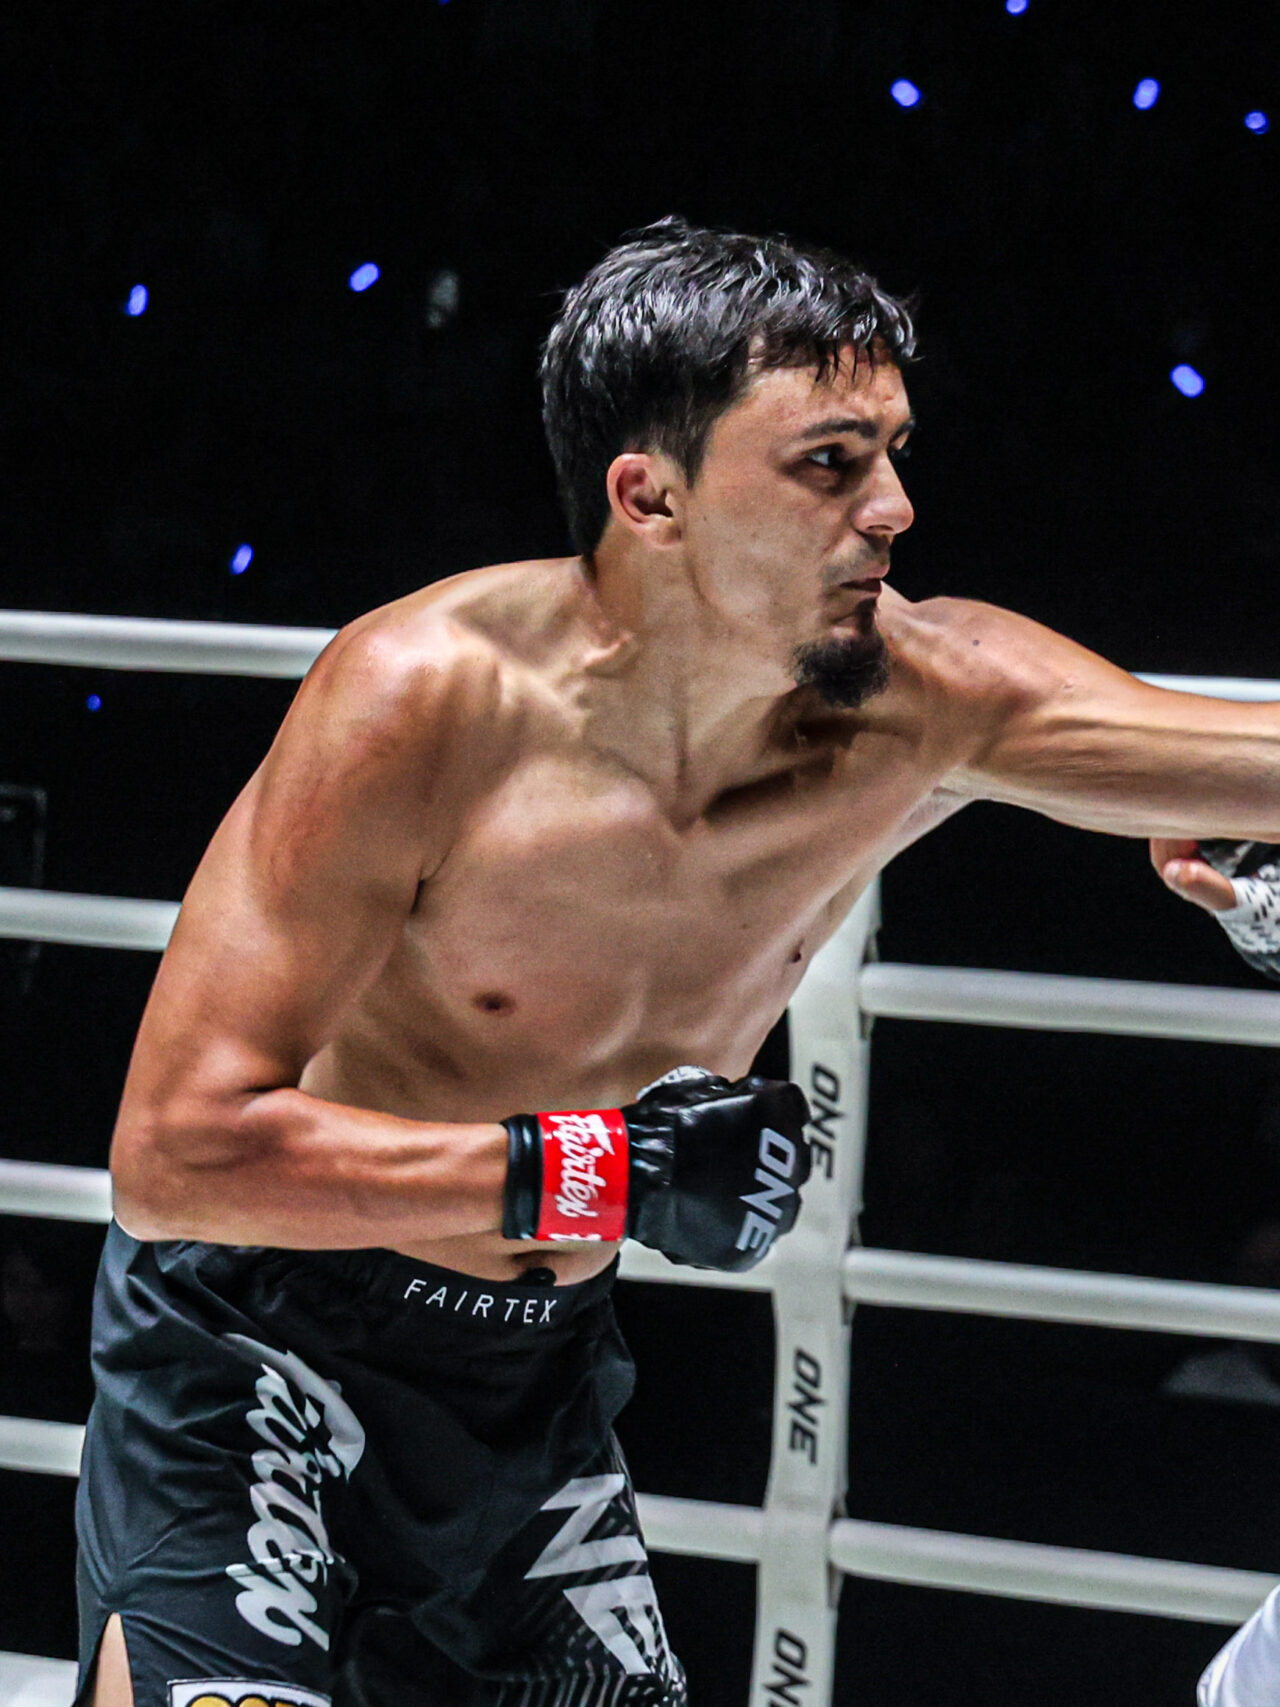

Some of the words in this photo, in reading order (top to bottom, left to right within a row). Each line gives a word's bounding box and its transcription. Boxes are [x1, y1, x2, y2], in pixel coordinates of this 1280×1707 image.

[548, 1114, 615, 1218] Fairtex
[808, 1063, 845, 1180] ONE
[735, 1127, 798, 1258] ONE
[404, 1278, 557, 1323] FAIRTEX
[785, 1346, 828, 1466] ONE
[763, 1628, 811, 1707] ON
